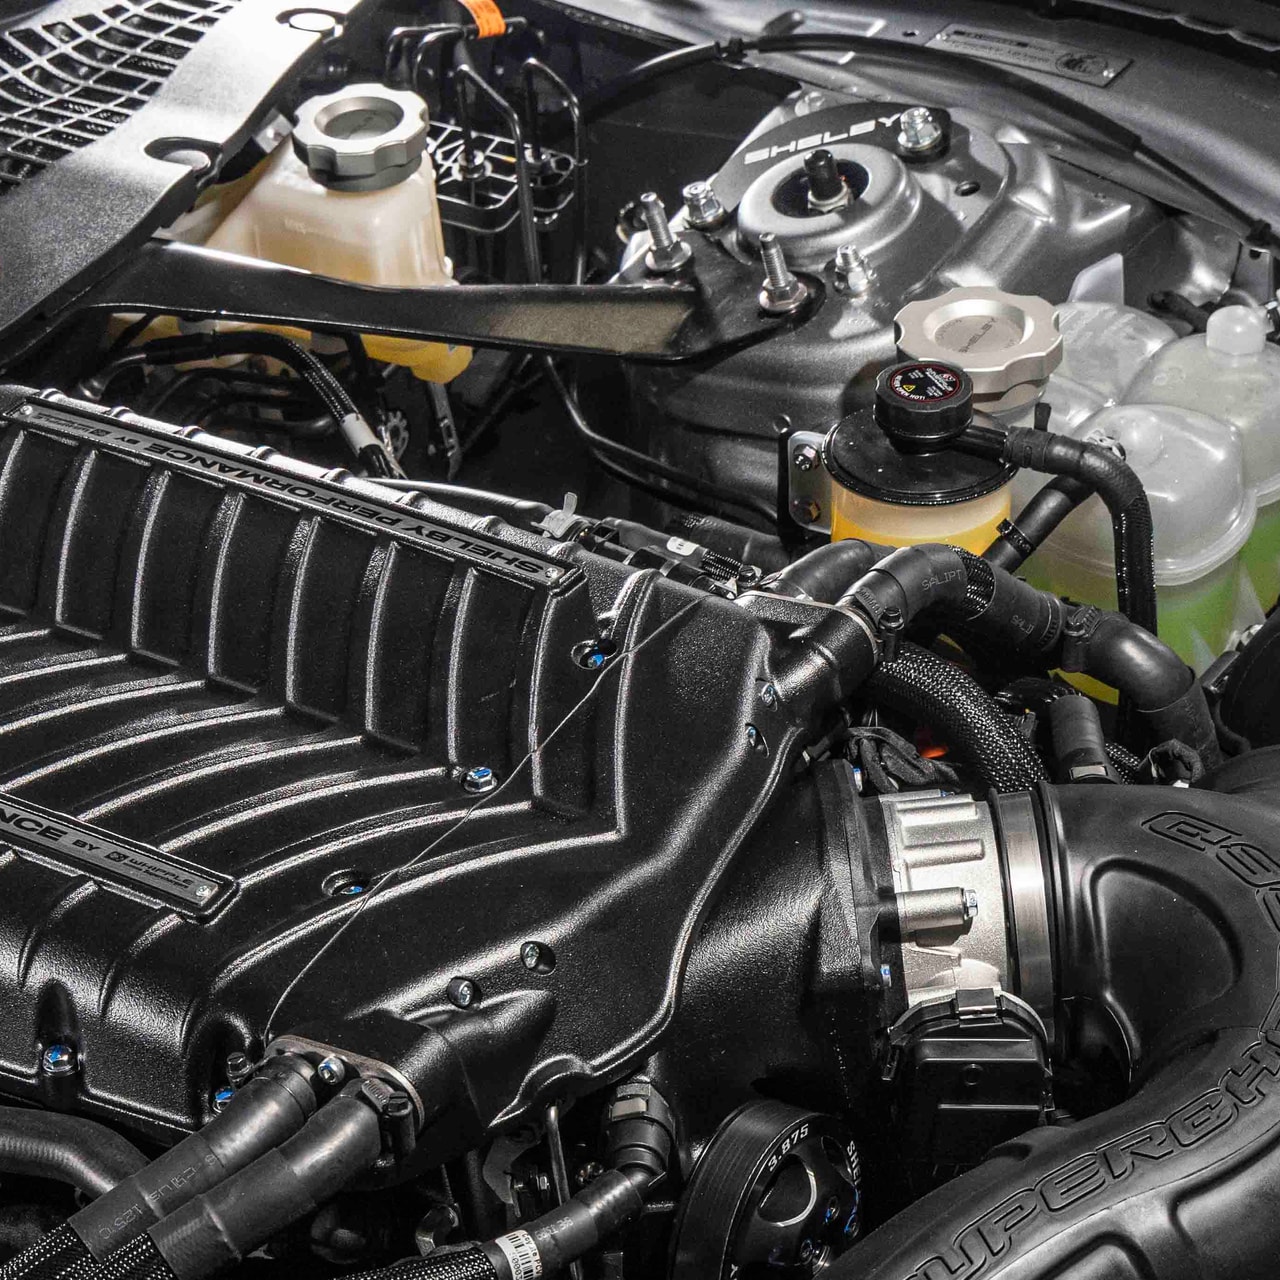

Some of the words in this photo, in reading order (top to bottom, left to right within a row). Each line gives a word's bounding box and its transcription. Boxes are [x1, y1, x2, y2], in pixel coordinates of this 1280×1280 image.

[744, 113, 901, 165] SHELBY
[114, 436, 140, 446] BY
[143, 442, 403, 527] PERFORMANCE
[404, 525, 541, 575] SHELBY
[71, 838, 100, 852] BY
[128, 857, 195, 886] WHIPPLE
[767, 1123, 810, 1172] 3.875
